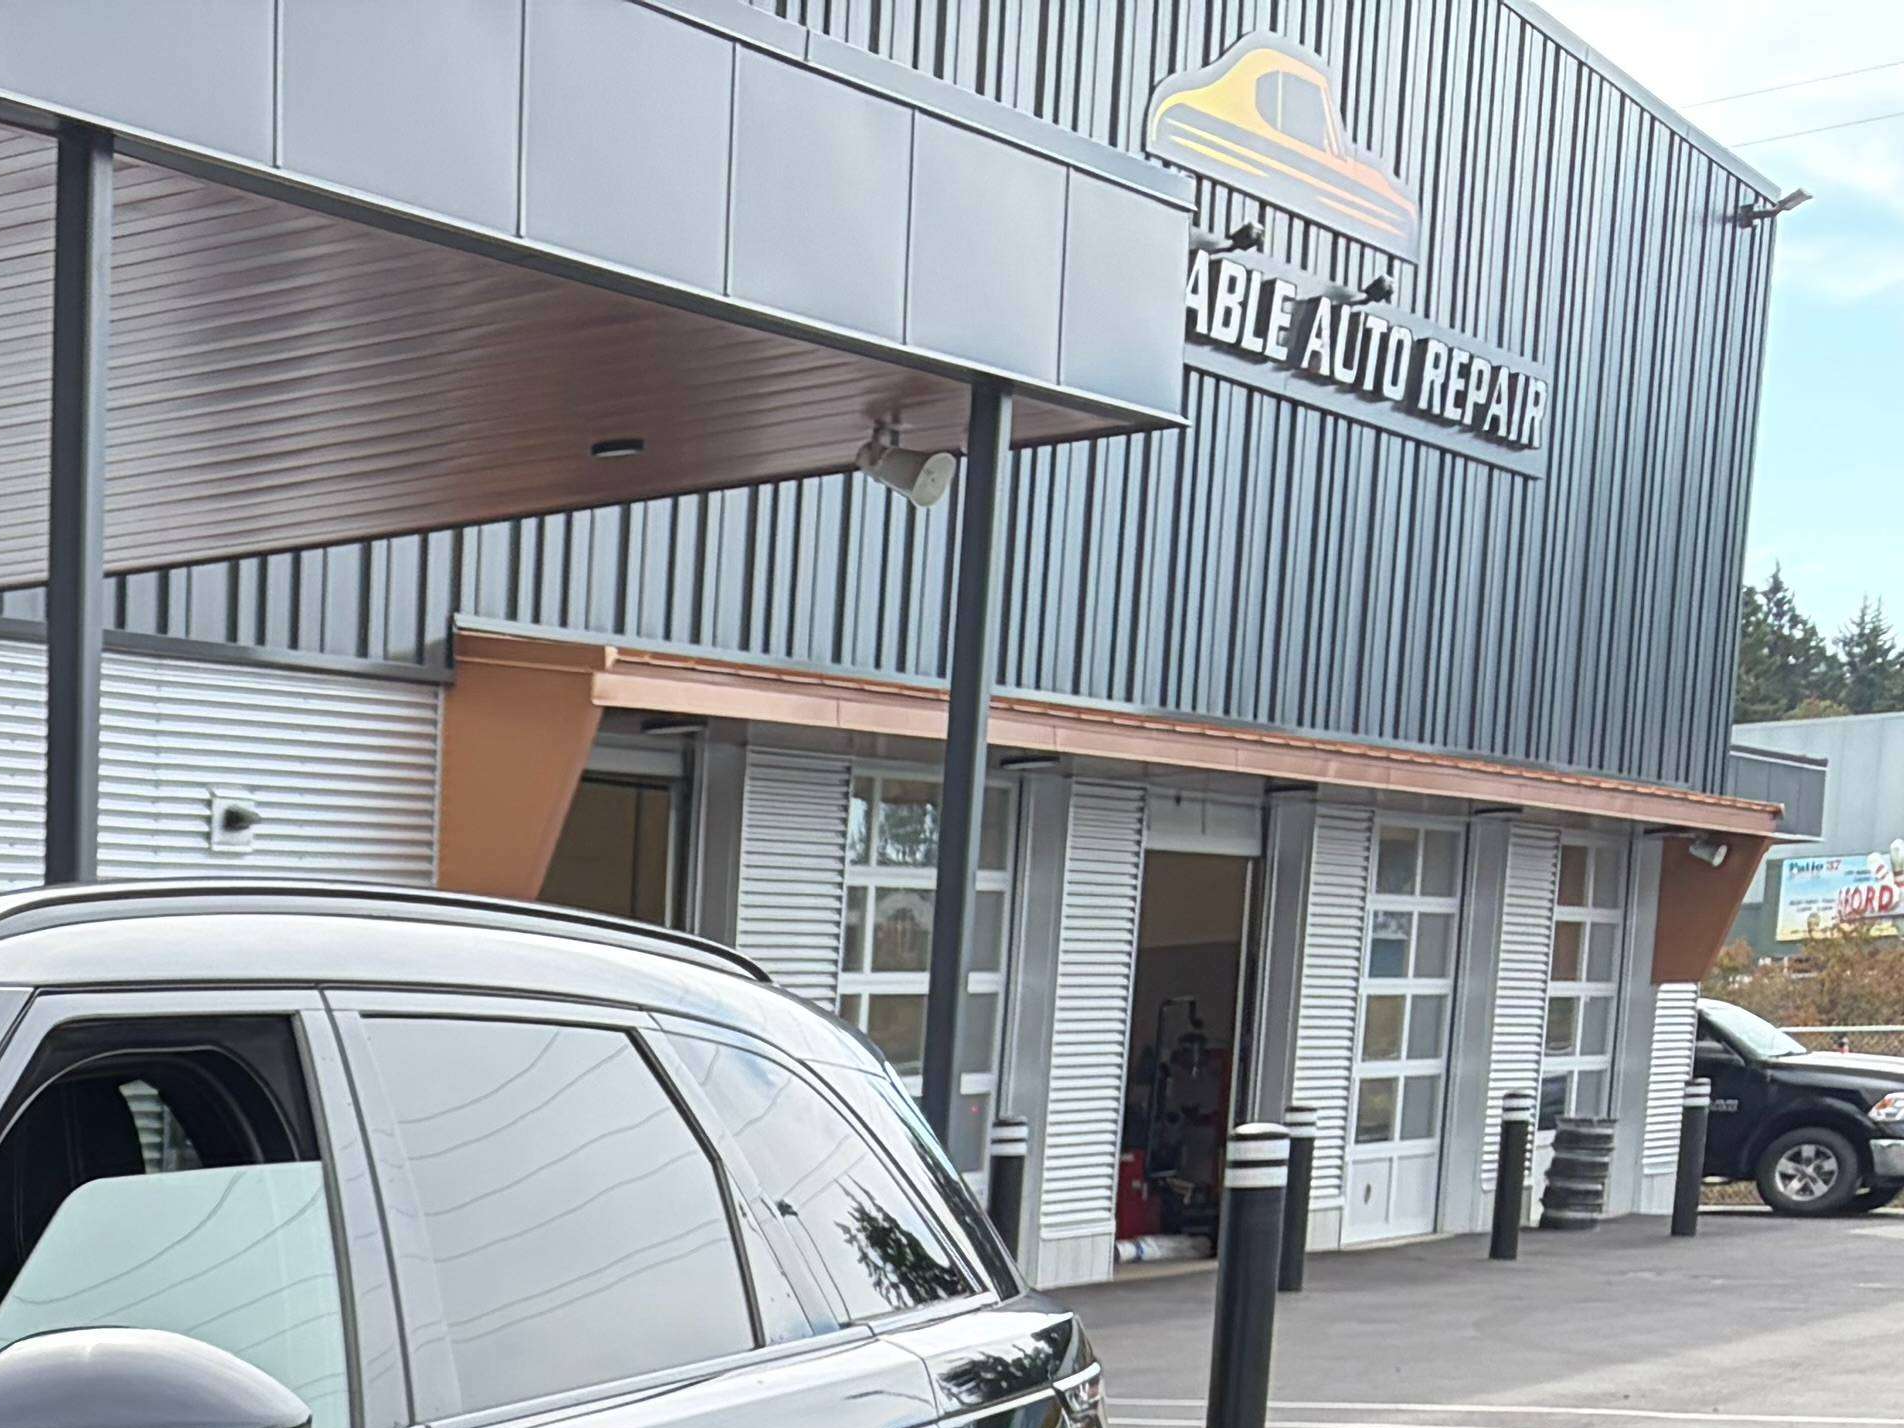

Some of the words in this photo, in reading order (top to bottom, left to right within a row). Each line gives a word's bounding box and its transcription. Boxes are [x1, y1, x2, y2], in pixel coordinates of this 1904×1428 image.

[1186, 249, 1297, 361] ABLE
[1301, 296, 1414, 401] AUTO
[1418, 337, 1548, 449] REPAIR
